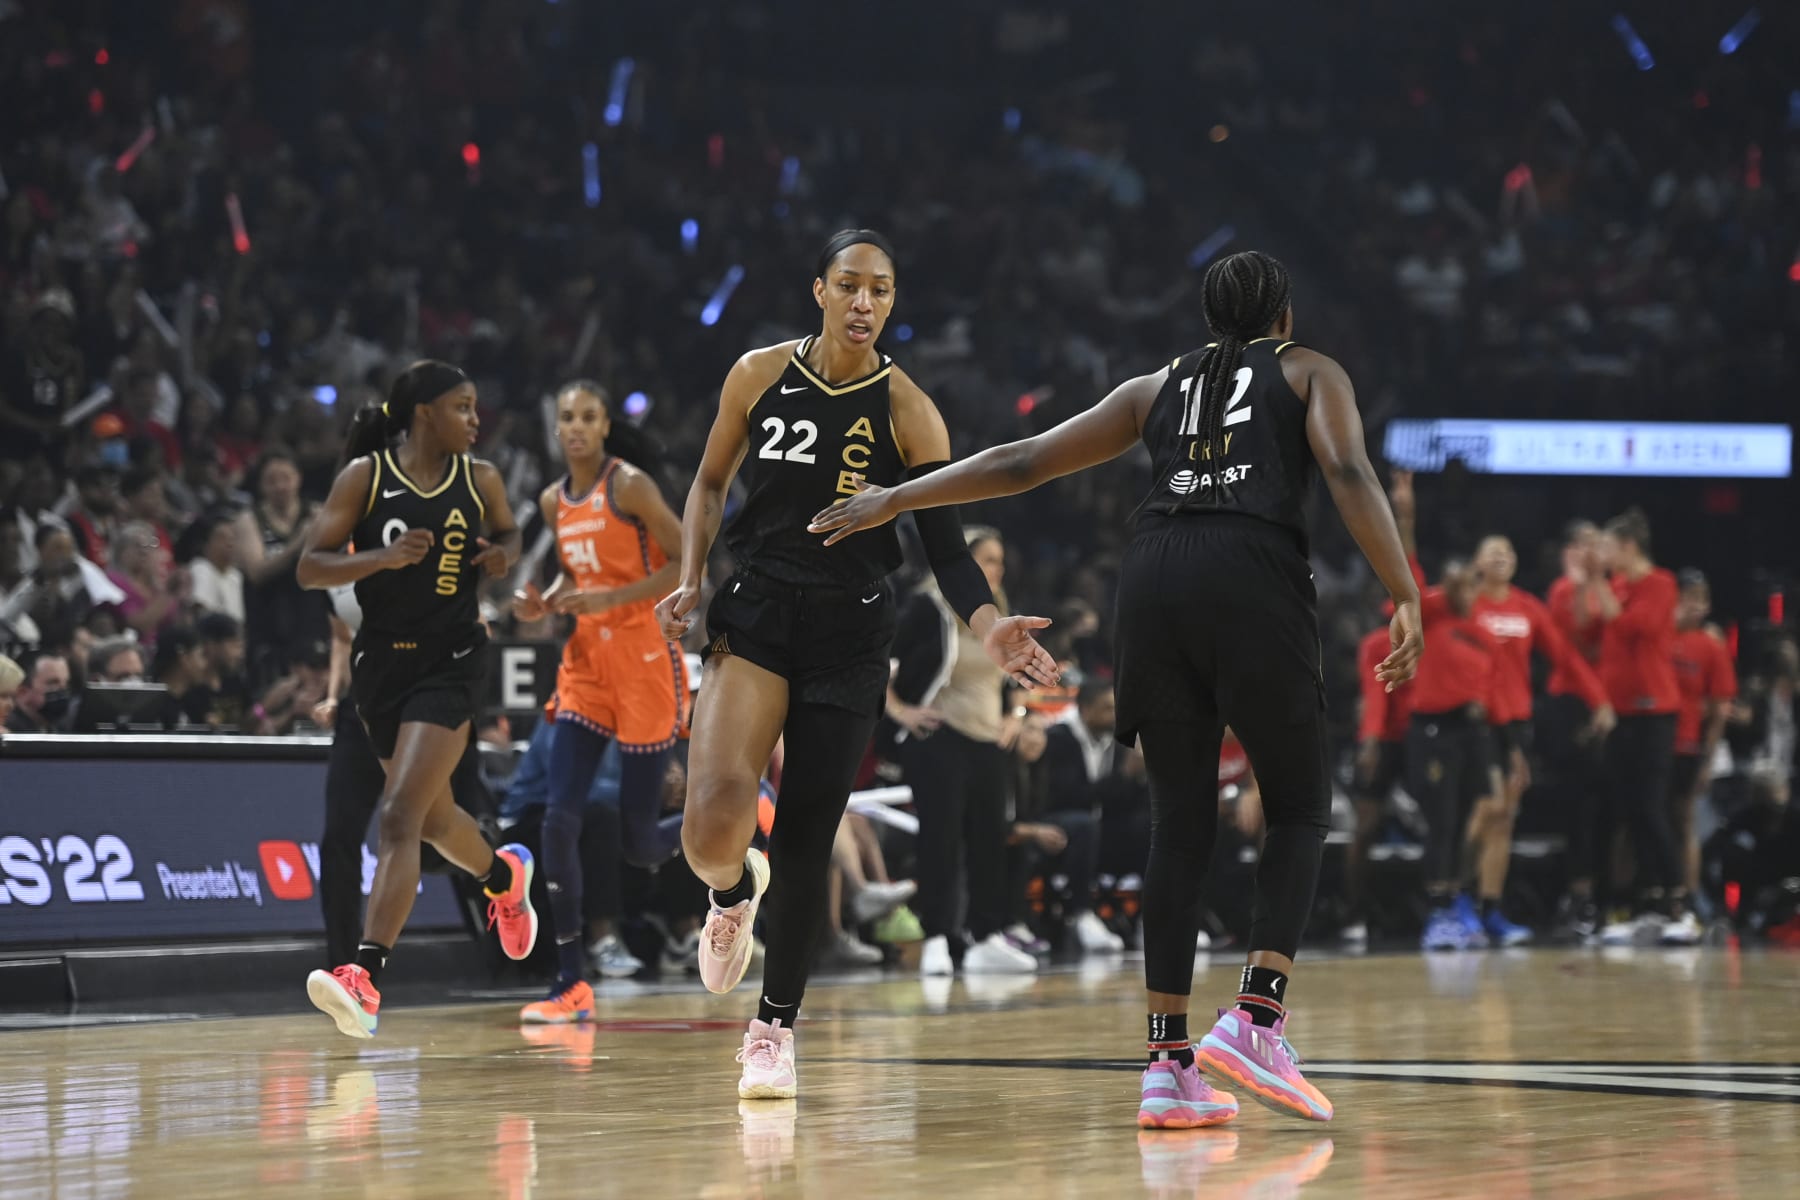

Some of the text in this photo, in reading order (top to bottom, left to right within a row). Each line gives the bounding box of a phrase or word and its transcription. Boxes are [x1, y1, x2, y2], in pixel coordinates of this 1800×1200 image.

[1178, 366, 1253, 435] 12
[759, 416, 818, 465] 22
[833, 416, 876, 507] ACE
[1650, 439, 1748, 466] ARENA
[435, 508, 468, 596] ACES
[501, 647, 538, 710] E
[0, 834, 145, 906] S'22
[156, 861, 239, 900] Presented
[233, 861, 263, 906] by
